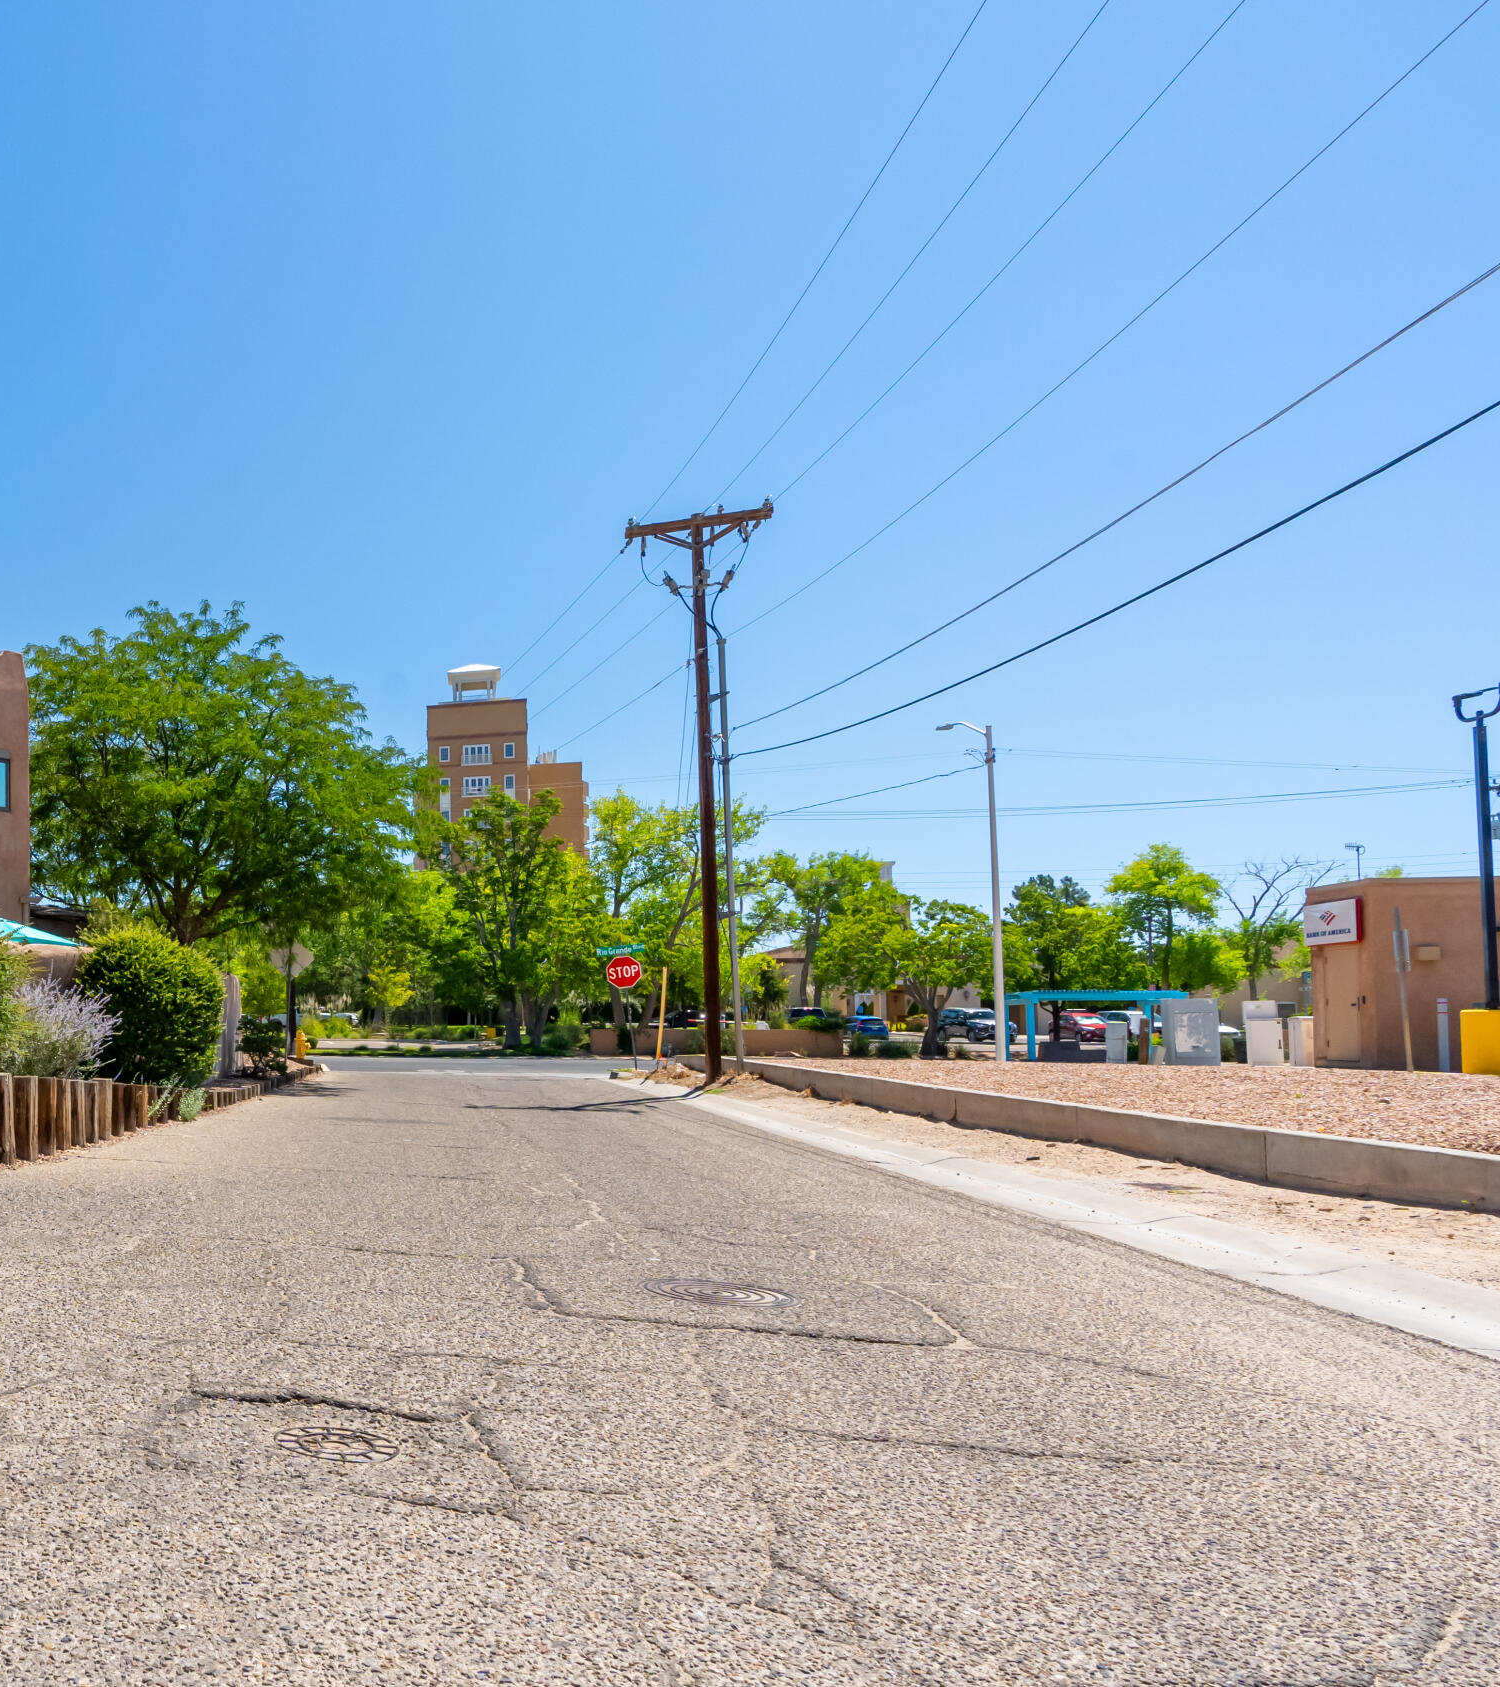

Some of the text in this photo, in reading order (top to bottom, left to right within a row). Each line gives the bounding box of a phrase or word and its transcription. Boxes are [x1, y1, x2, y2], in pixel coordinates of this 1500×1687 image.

[597, 948, 607, 956] Rio
[608, 946, 631, 955] Grande
[609, 965, 638, 979] STOP
